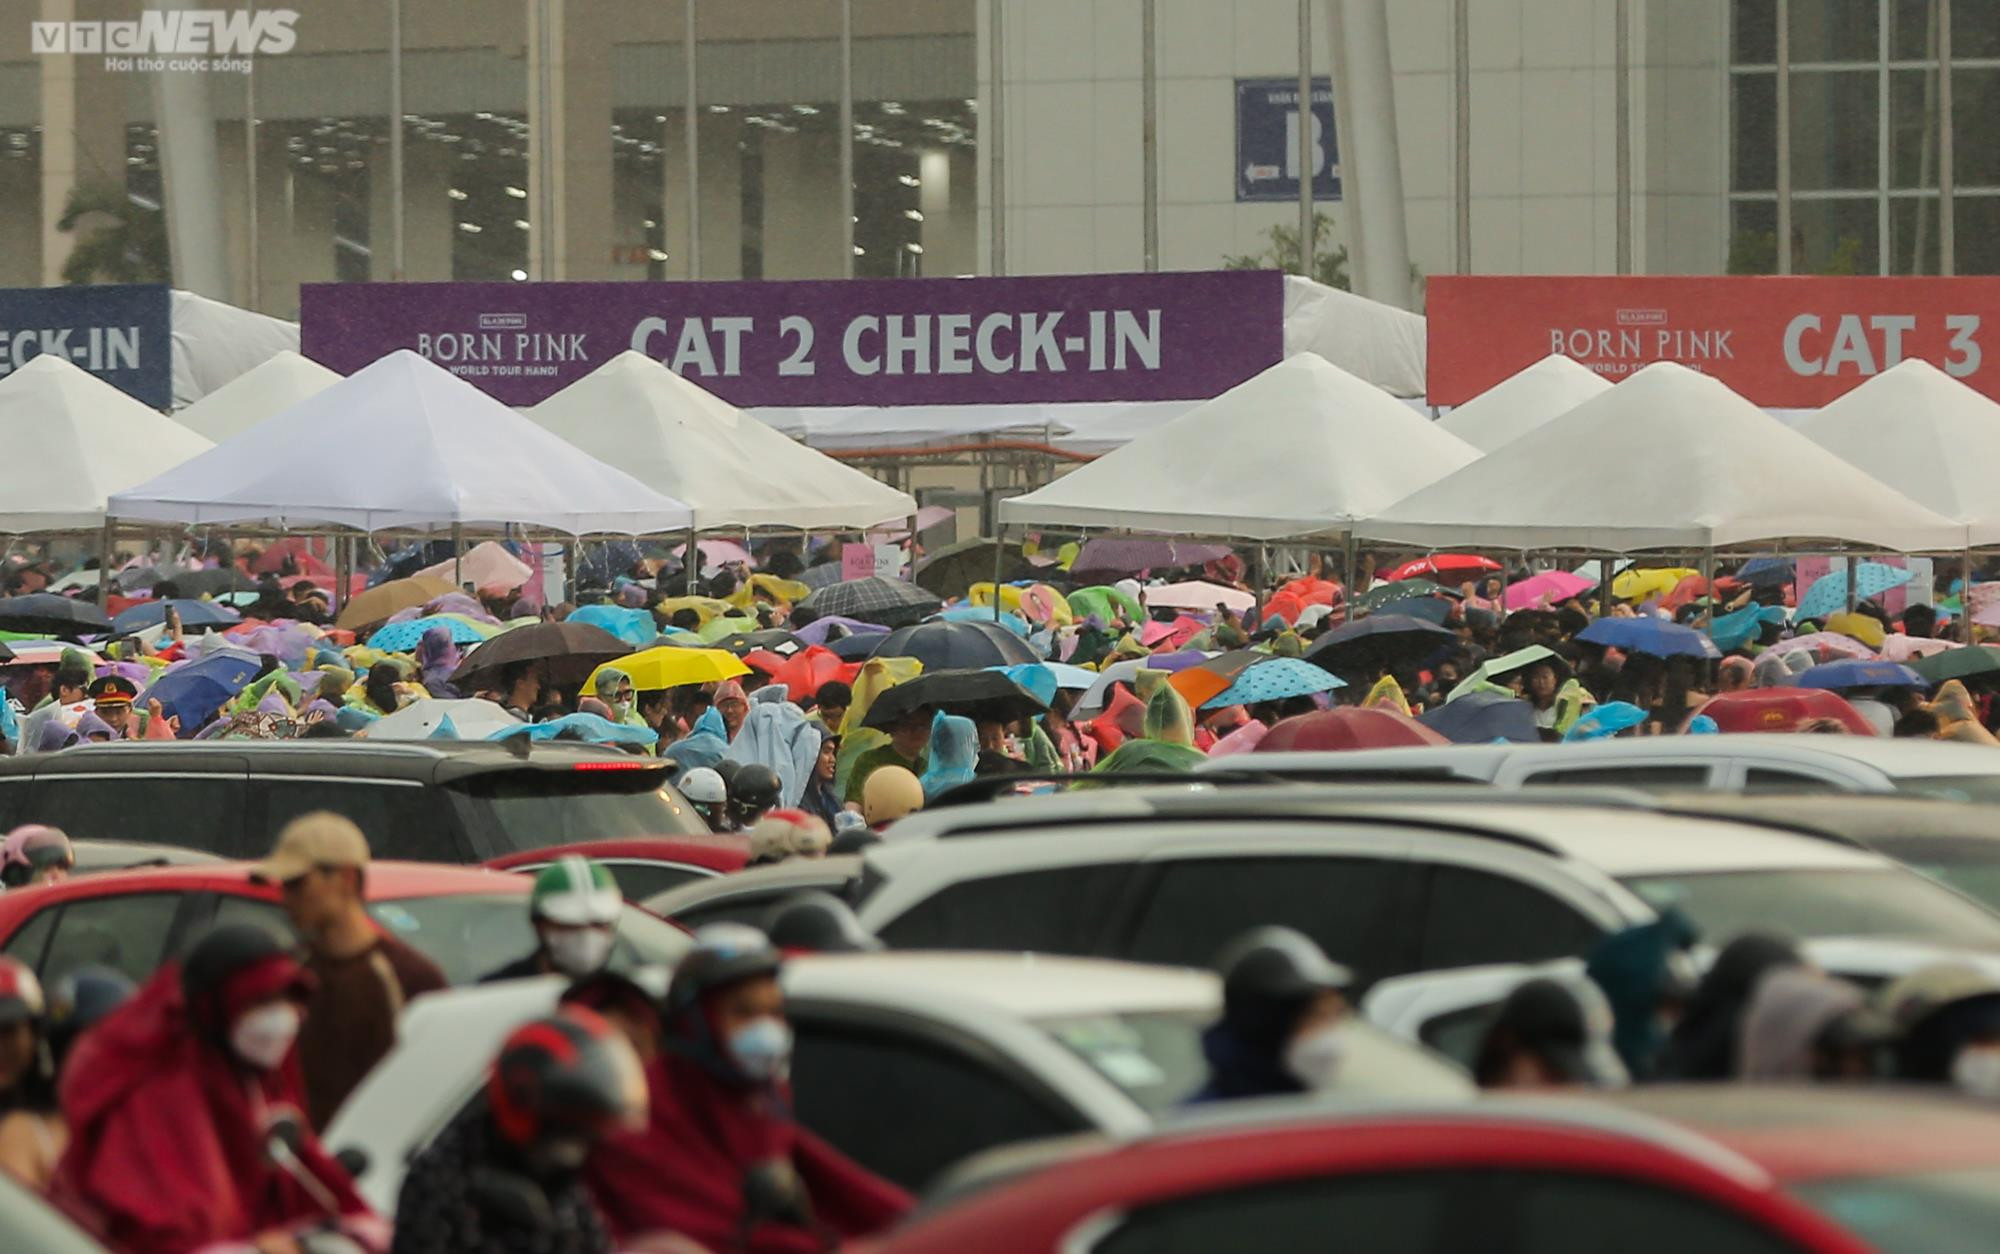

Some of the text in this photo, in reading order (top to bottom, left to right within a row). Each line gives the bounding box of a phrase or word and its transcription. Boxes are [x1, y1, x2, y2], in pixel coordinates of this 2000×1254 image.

[418, 333, 589, 362] BORN PINK
[631, 308, 1162, 377] CAT 2 CHECK-IN
[1550, 328, 1735, 360] BORN PINK
[1783, 313, 1982, 378] CAT 3
[450, 365, 489, 376] WORLD
[493, 366, 521, 376] TOUR
